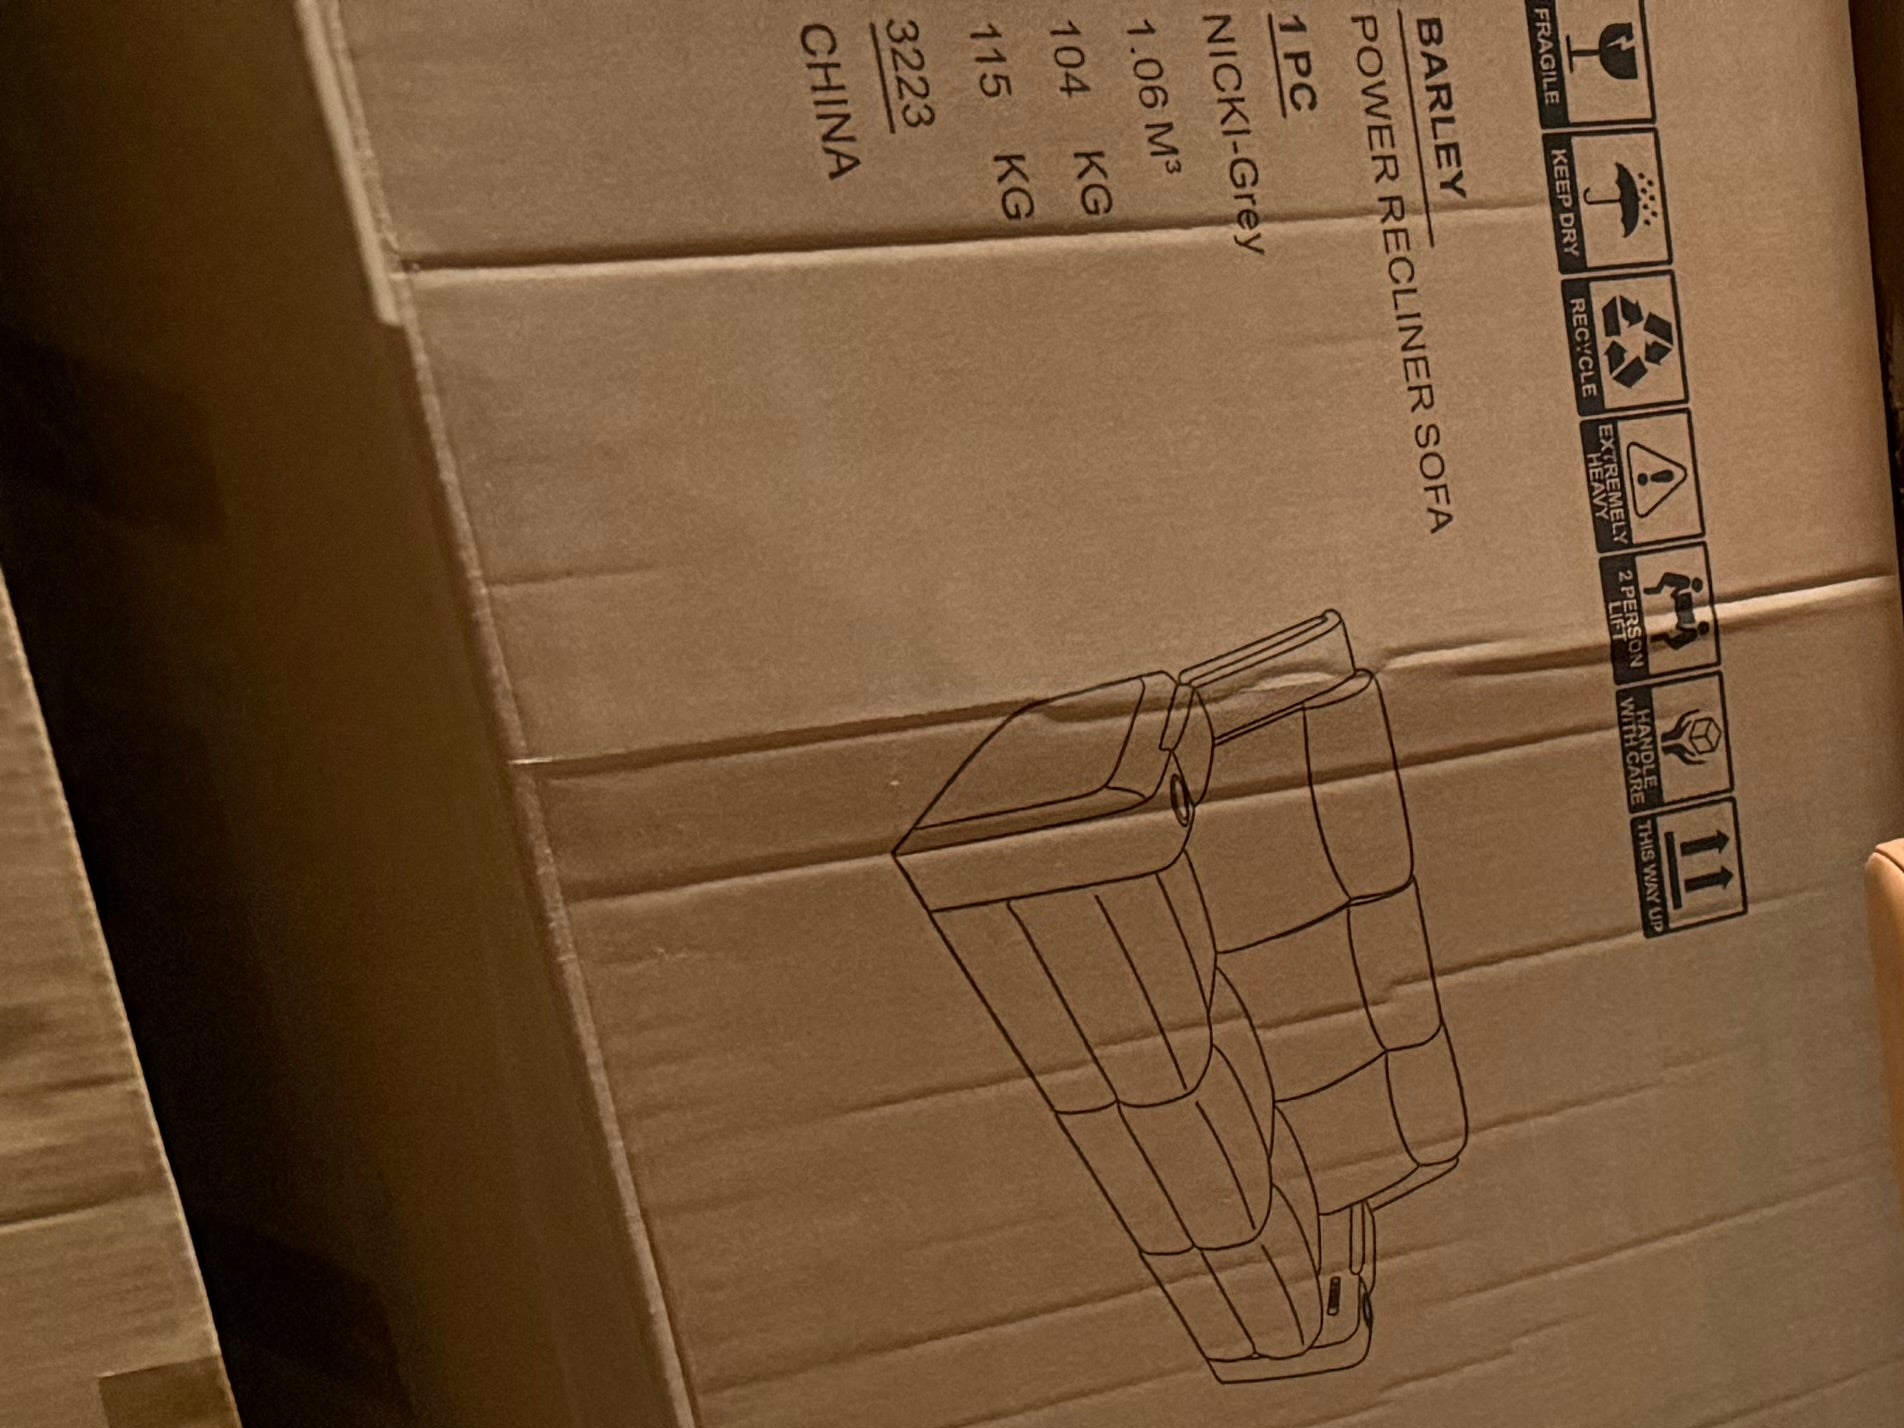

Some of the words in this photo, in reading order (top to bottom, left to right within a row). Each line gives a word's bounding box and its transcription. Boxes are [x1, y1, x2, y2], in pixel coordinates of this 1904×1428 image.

[1127, 19, 1169, 109] 1.06
[1279, 14, 1308, 33] 1
[1533, 7, 1560, 105] FRAGILE
[800, 23, 861, 181] CHINA
[886, 19, 935, 128] 3223
[1283, 51, 1317, 111] PC
[1417, 17, 1467, 199] BARLEY
[969, 23, 1012, 98] 115
[993, 154, 1034, 221] KG
[1050, 20, 1091, 98] 104
[1073, 150, 1113, 216] KG
[1203, 14, 1265, 255] NICKI-Grey
[1551, 149, 1573, 208] KEEP
[1351, 15, 1400, 183] POWER
[1377, 195, 1435, 413] RECLINER
[1415, 424, 1454, 535] SOFA
[1559, 211, 1581, 258] DRY
[1570, 298, 1597, 397] RECYCLE
[1586, 453, 1610, 520] HEAVY
[1598, 424, 1629, 545] EXTREMELY
[1618, 570, 1634, 581] 2
[1608, 601, 1628, 643] LIFT
[1622, 586, 1645, 668] PERSON
[1620, 696, 1638, 750] WITH
[1637, 708, 1659, 790] HANDLE
[1627, 752, 1646, 806] CARE
[1637, 817, 1656, 863] THIS
[1642, 864, 1660, 907] WAY
[1648, 907, 1665, 935] UP
